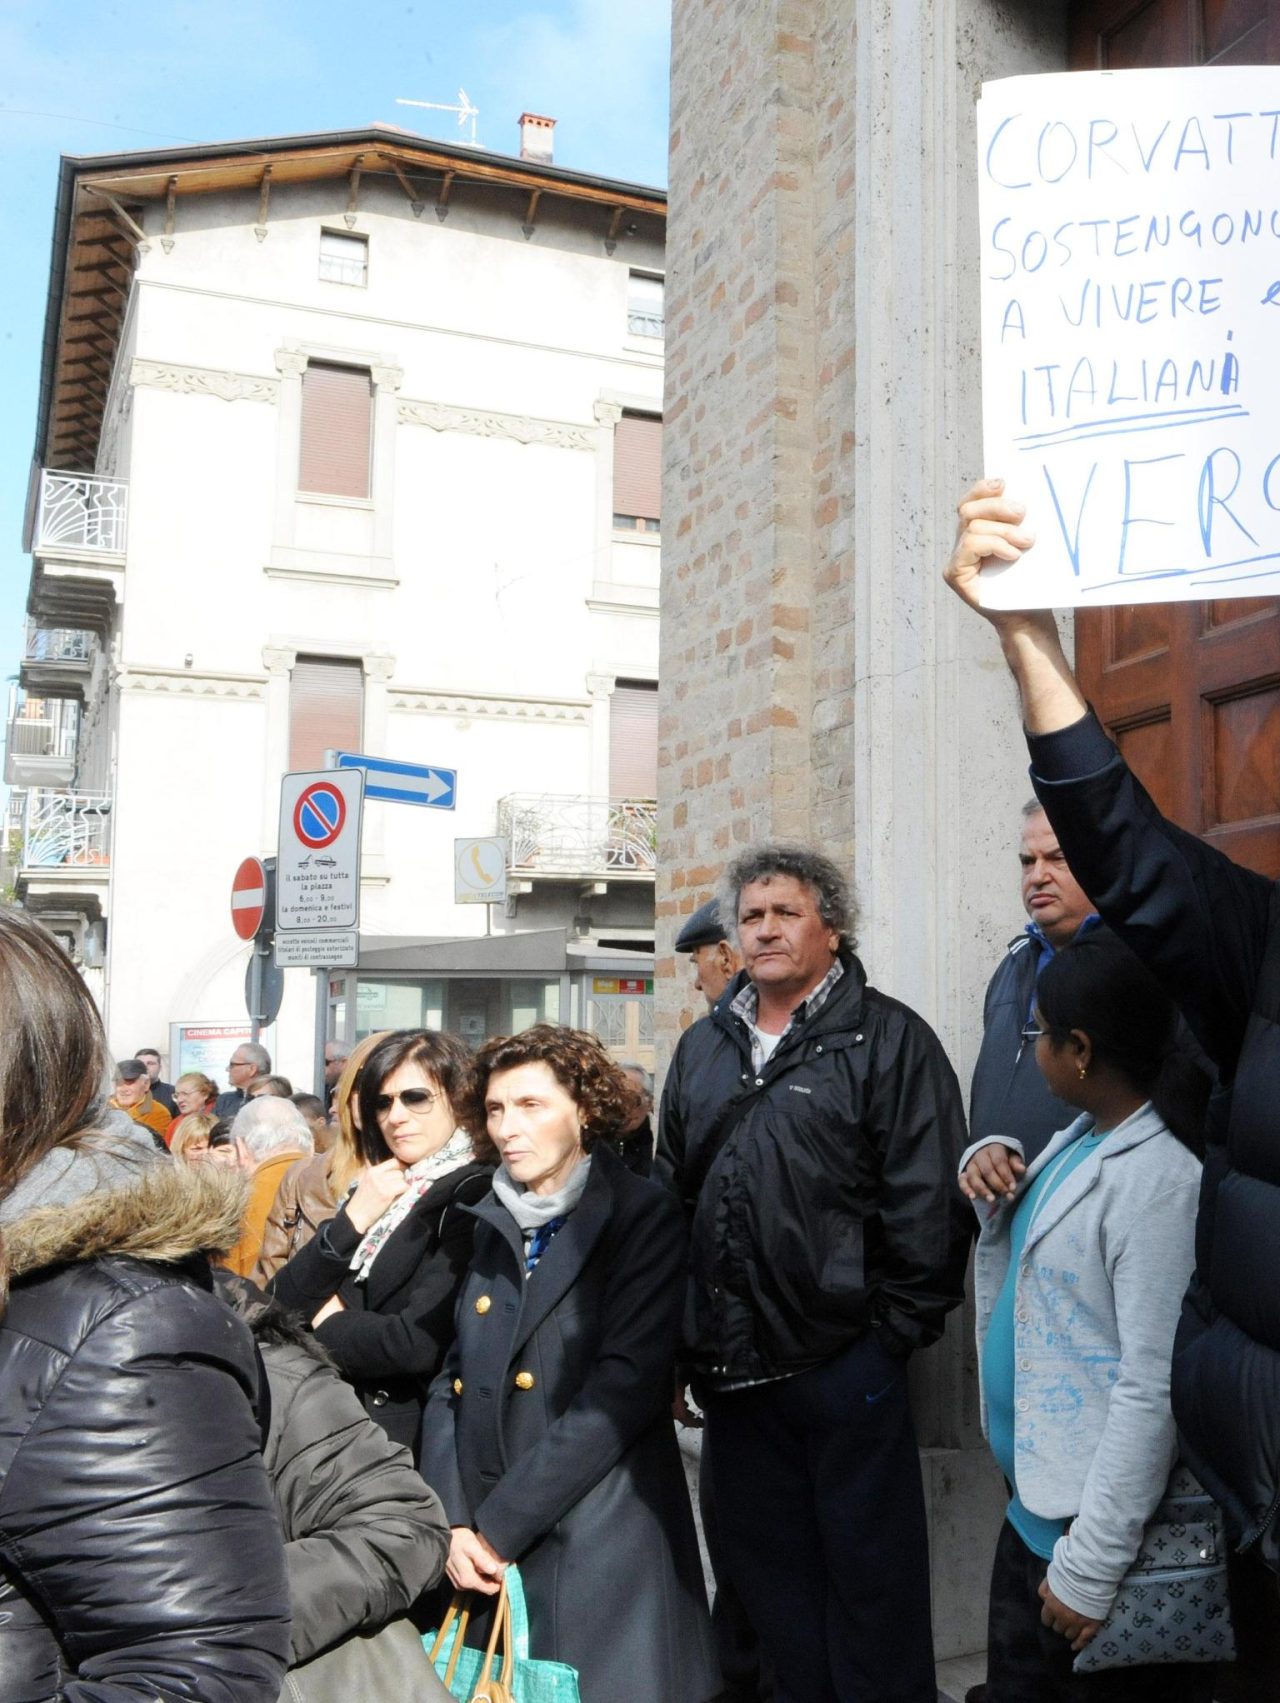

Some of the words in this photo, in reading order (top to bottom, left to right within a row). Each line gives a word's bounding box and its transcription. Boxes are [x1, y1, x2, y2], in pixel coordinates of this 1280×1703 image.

[1001, 299, 1027, 344] A
[1058, 277, 1223, 329] VIVERE
[293, 873, 318, 882] sabato
[319, 872, 328, 880] su
[330, 871, 350, 880] tutta
[301, 883, 308, 891] la
[310, 883, 332, 891] piazza
[282, 905, 289, 913] la
[290, 904, 323, 913] domenica
[330, 903, 353, 911] festivi
[187, 1028, 222, 1036] CINEMA
